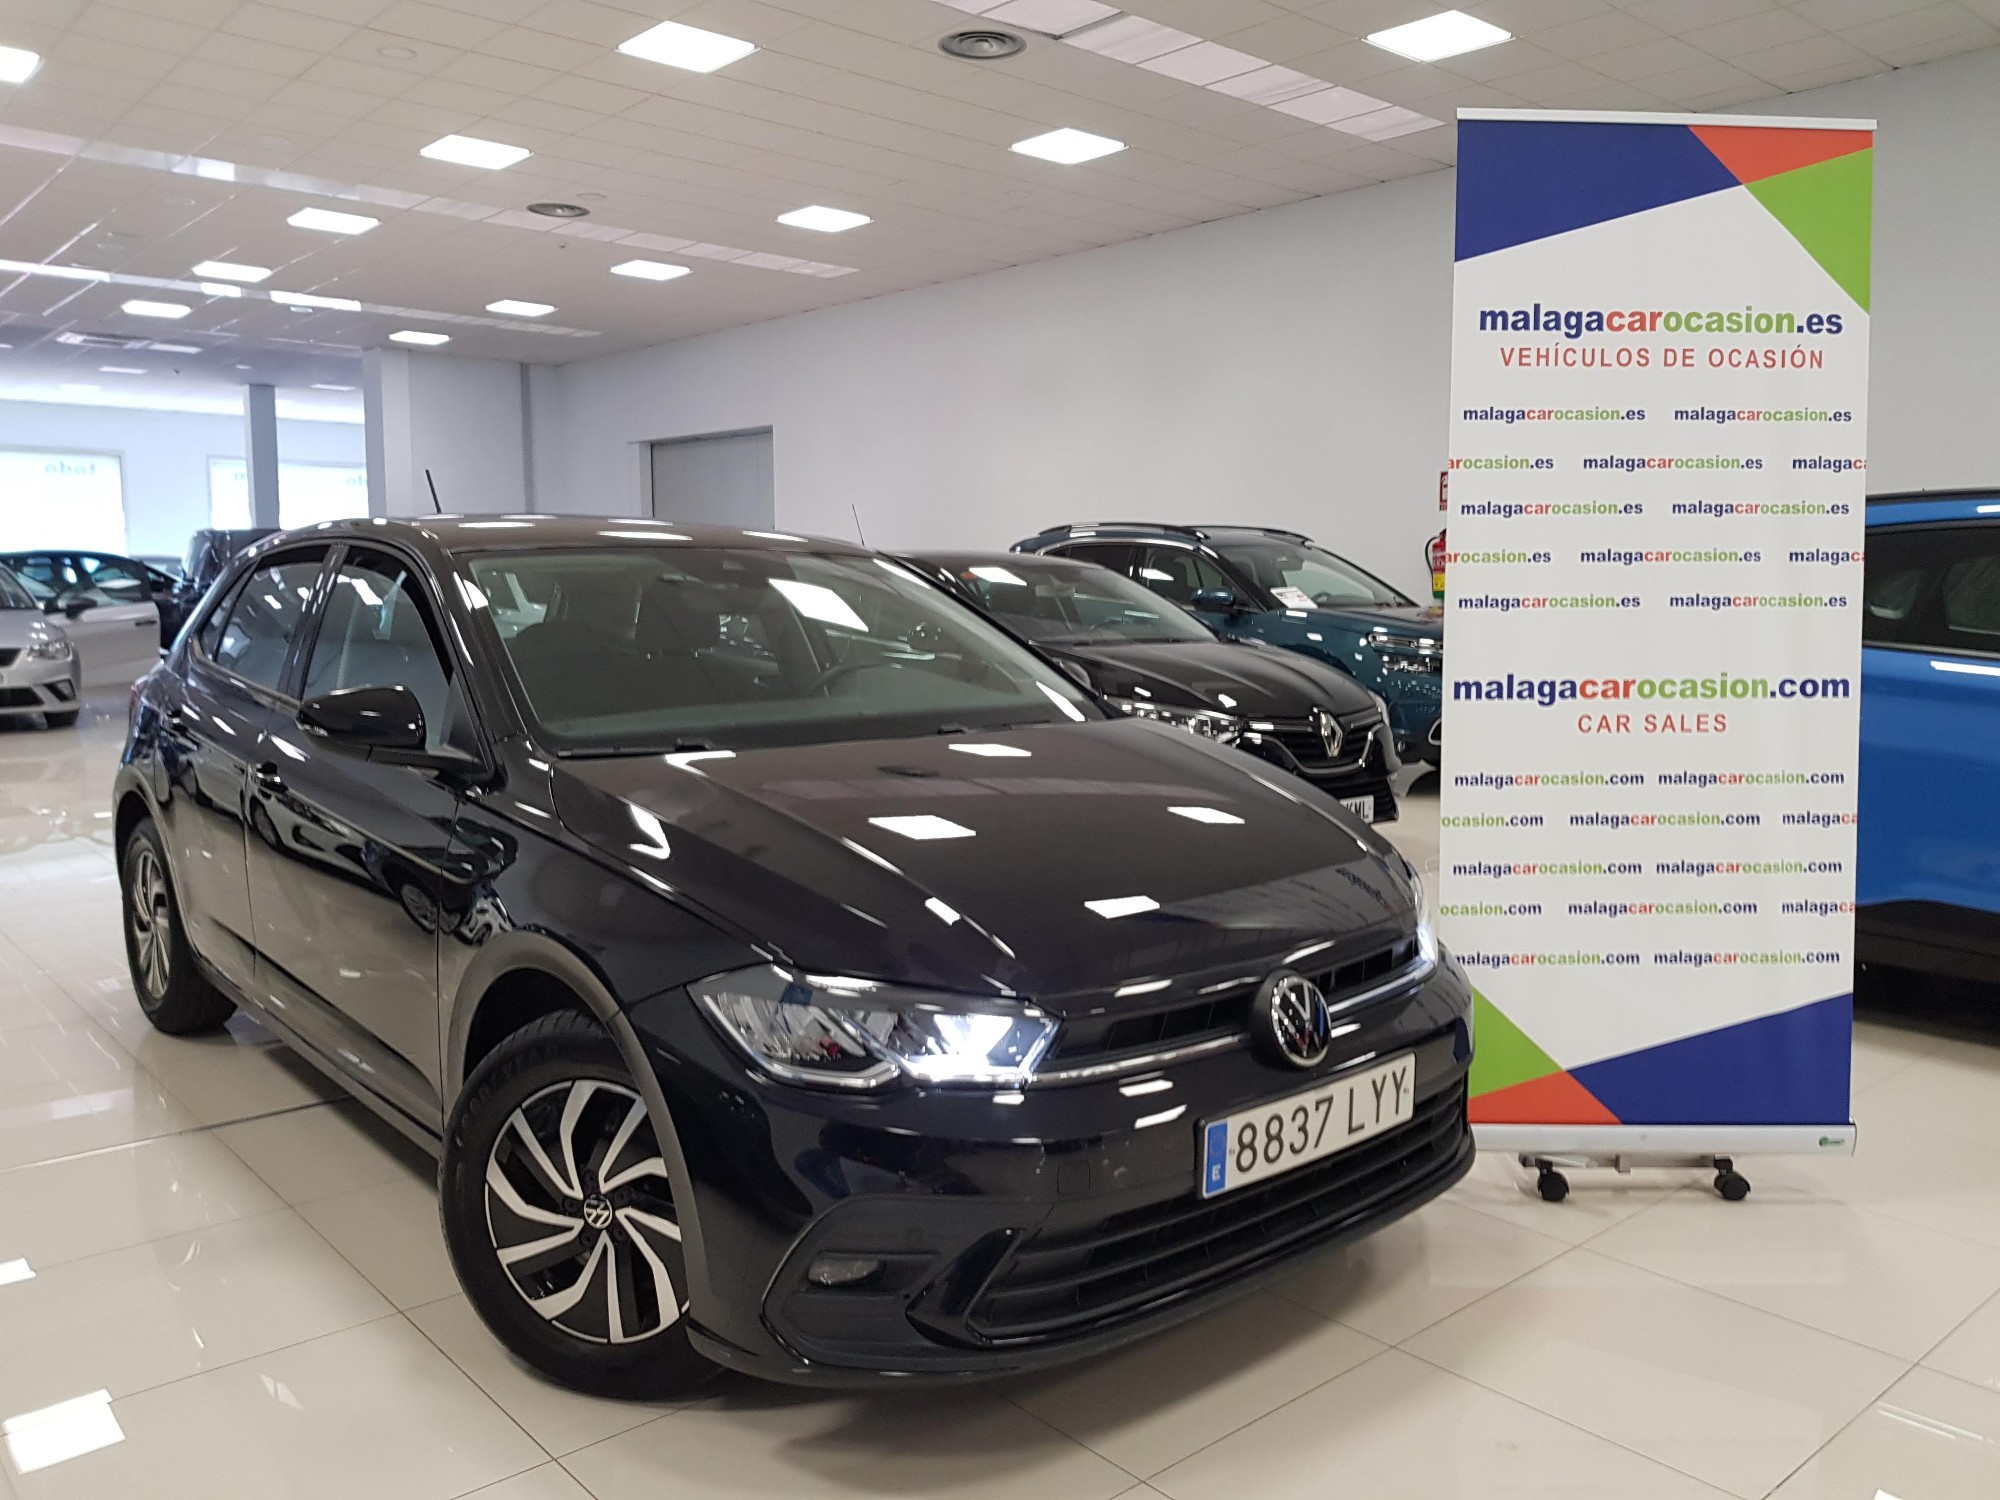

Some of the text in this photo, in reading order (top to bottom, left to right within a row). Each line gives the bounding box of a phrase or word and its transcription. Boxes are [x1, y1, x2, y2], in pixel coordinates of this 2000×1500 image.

[1480, 303, 1842, 339] malagacarocasion.es
[1501, 343, 1822, 368] VEHÍCULOS DE OCASIÓN
[1464, 407, 1645, 424] malagacarocasion.es
[1675, 407, 1851, 424] malagacarocasion.es
[1584, 455, 1762, 472] malagacarocasion.es
[1793, 456, 1866, 473] malagac
[1461, 501, 1643, 518] malagacarocasion.es
[1673, 500, 1849, 517] malagacarocasion.es
[1581, 548, 1761, 566] malagacarocasion.es
[1459, 594, 1640, 612] malagacarocasion.es
[1670, 593, 1847, 611] malagacarocasion.es
[1454, 672, 1849, 707] malagacarocasion.com
[1578, 714, 1726, 733] CAR SALES
[1455, 772, 1644, 789] malagacarocasion.com
[1659, 770, 1844, 788] malagacarocasion.com
[1442, 814, 1543, 827] ocasion.com
[1570, 812, 1760, 829] malagacarocasion.com
[1453, 861, 1642, 878] malagacarocasion.com
[1657, 860, 1842, 877] malagacarocasion.com
[1440, 902, 1541, 916] ocasion.com
[1569, 901, 1757, 918] malagacarocasion.com
[1654, 950, 1839, 967] malagacarocasion.com
[1236, 1066, 1407, 1173] 8837 LYY
